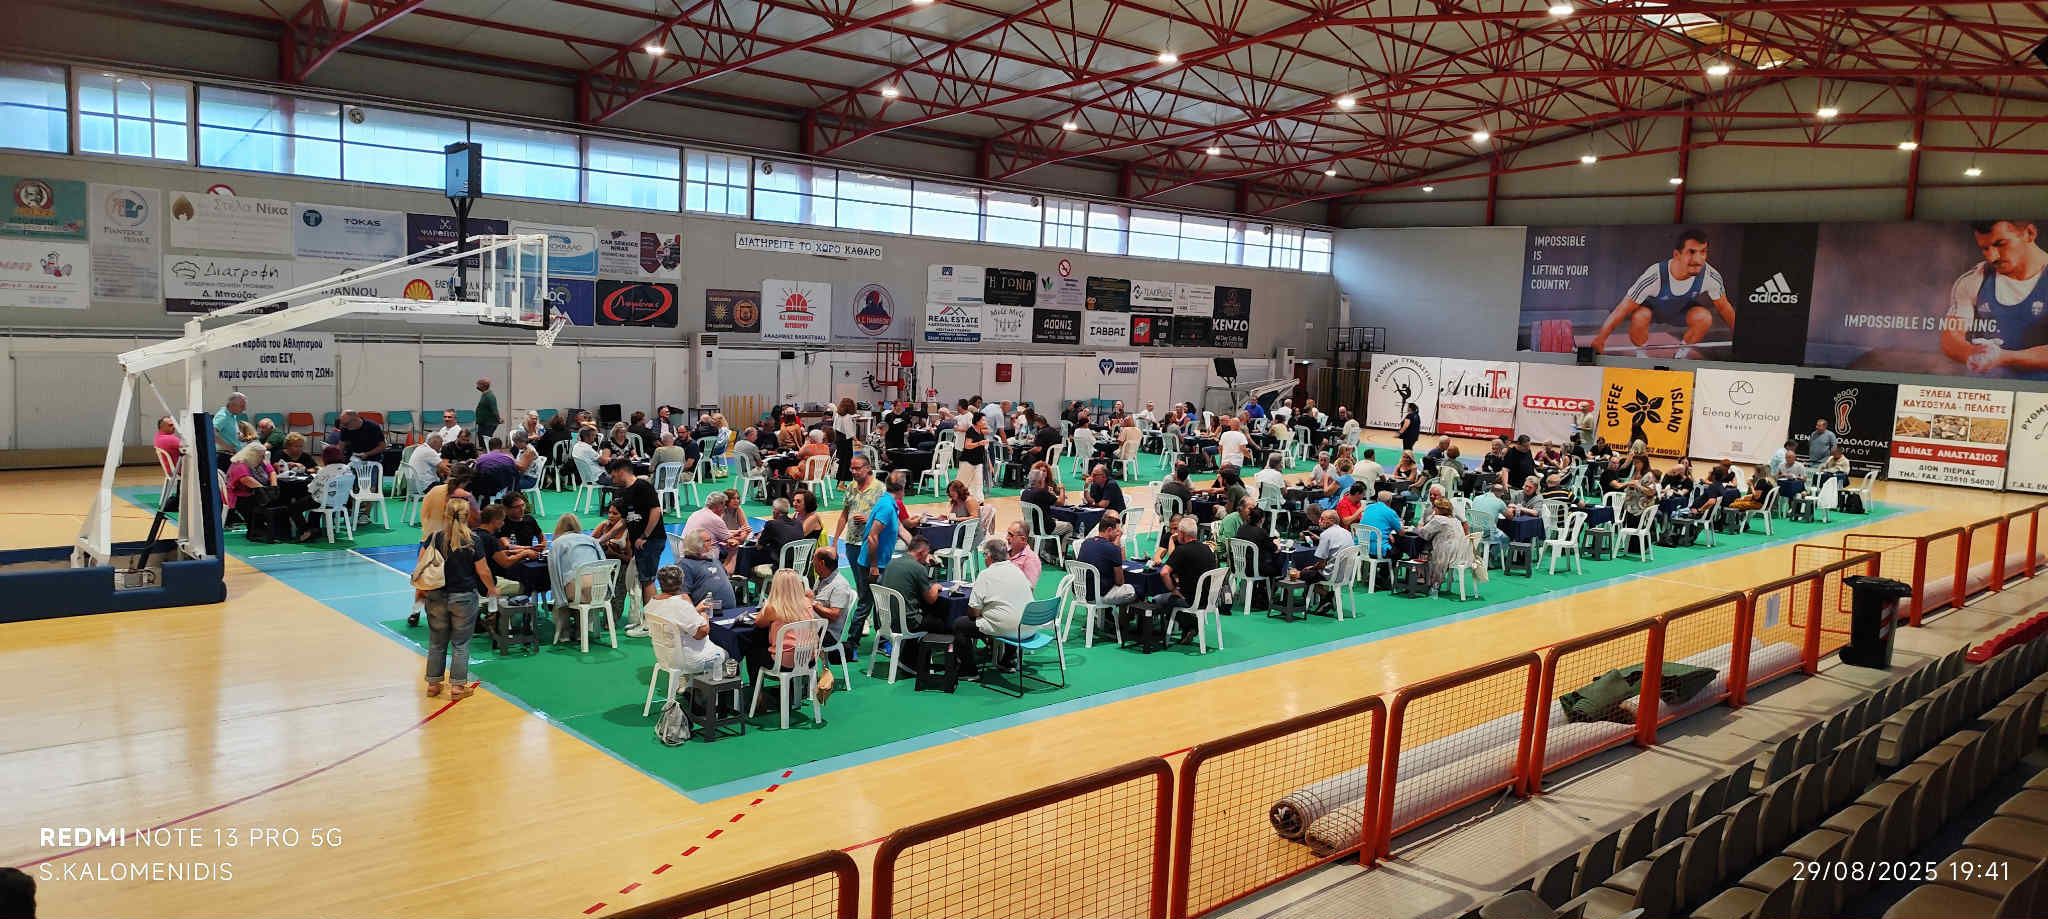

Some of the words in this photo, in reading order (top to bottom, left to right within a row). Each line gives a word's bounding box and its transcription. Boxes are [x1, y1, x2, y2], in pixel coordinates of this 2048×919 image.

[343, 218, 381, 227] TOKAS
[738, 238, 794, 250] ΔΙΑΤΗΡΕΙΤΕ
[799, 241, 812, 251] ΤΟ
[816, 243, 840, 253] ΧΩΡΟ
[845, 245, 881, 256] ΚΑΘΑΡΟ
[1534, 235, 1586, 247] IMPOSSIBLE
[1533, 250, 1543, 261] IS
[1532, 264, 1564, 276] LIFTING
[1566, 265, 1589, 276] YOUR
[1531, 279, 1572, 290] COUNTRY.
[1749, 291, 1799, 304] adidas
[928, 315, 950, 323] REAL
[951, 316, 979, 324] ESTATE
[1212, 318, 1249, 331] KENZO
[1844, 314, 1918, 330] IMPOSSIBLE
[1922, 317, 1935, 331] IS
[1938, 318, 2000, 333] NOTHING.
[1920, 389, 1952, 399] ΞΥΛΕΙΑ
[1957, 391, 1993, 401] ΣΤΕΓΗΣ
[1607, 383, 1624, 428] COFFEE
[1667, 387, 1684, 433] ISLAND
[1903, 399, 1957, 410] ΚΑΥΣΟΞΥΛΑ
[1702, 406, 1731, 418] Elena
[1734, 409, 1780, 421] Kypraiou
[1837, 438, 1888, 449] ΟΔΟΛΟΓΙΑΣ
[1937, 449, 1999, 463] ΑΝΑΣΤΑΣΙΟΣ
[1919, 464, 1939, 472] ΔΙΟΝ
[1944, 466, 1977, 476] ΠΙΕΡΙΑΣ
